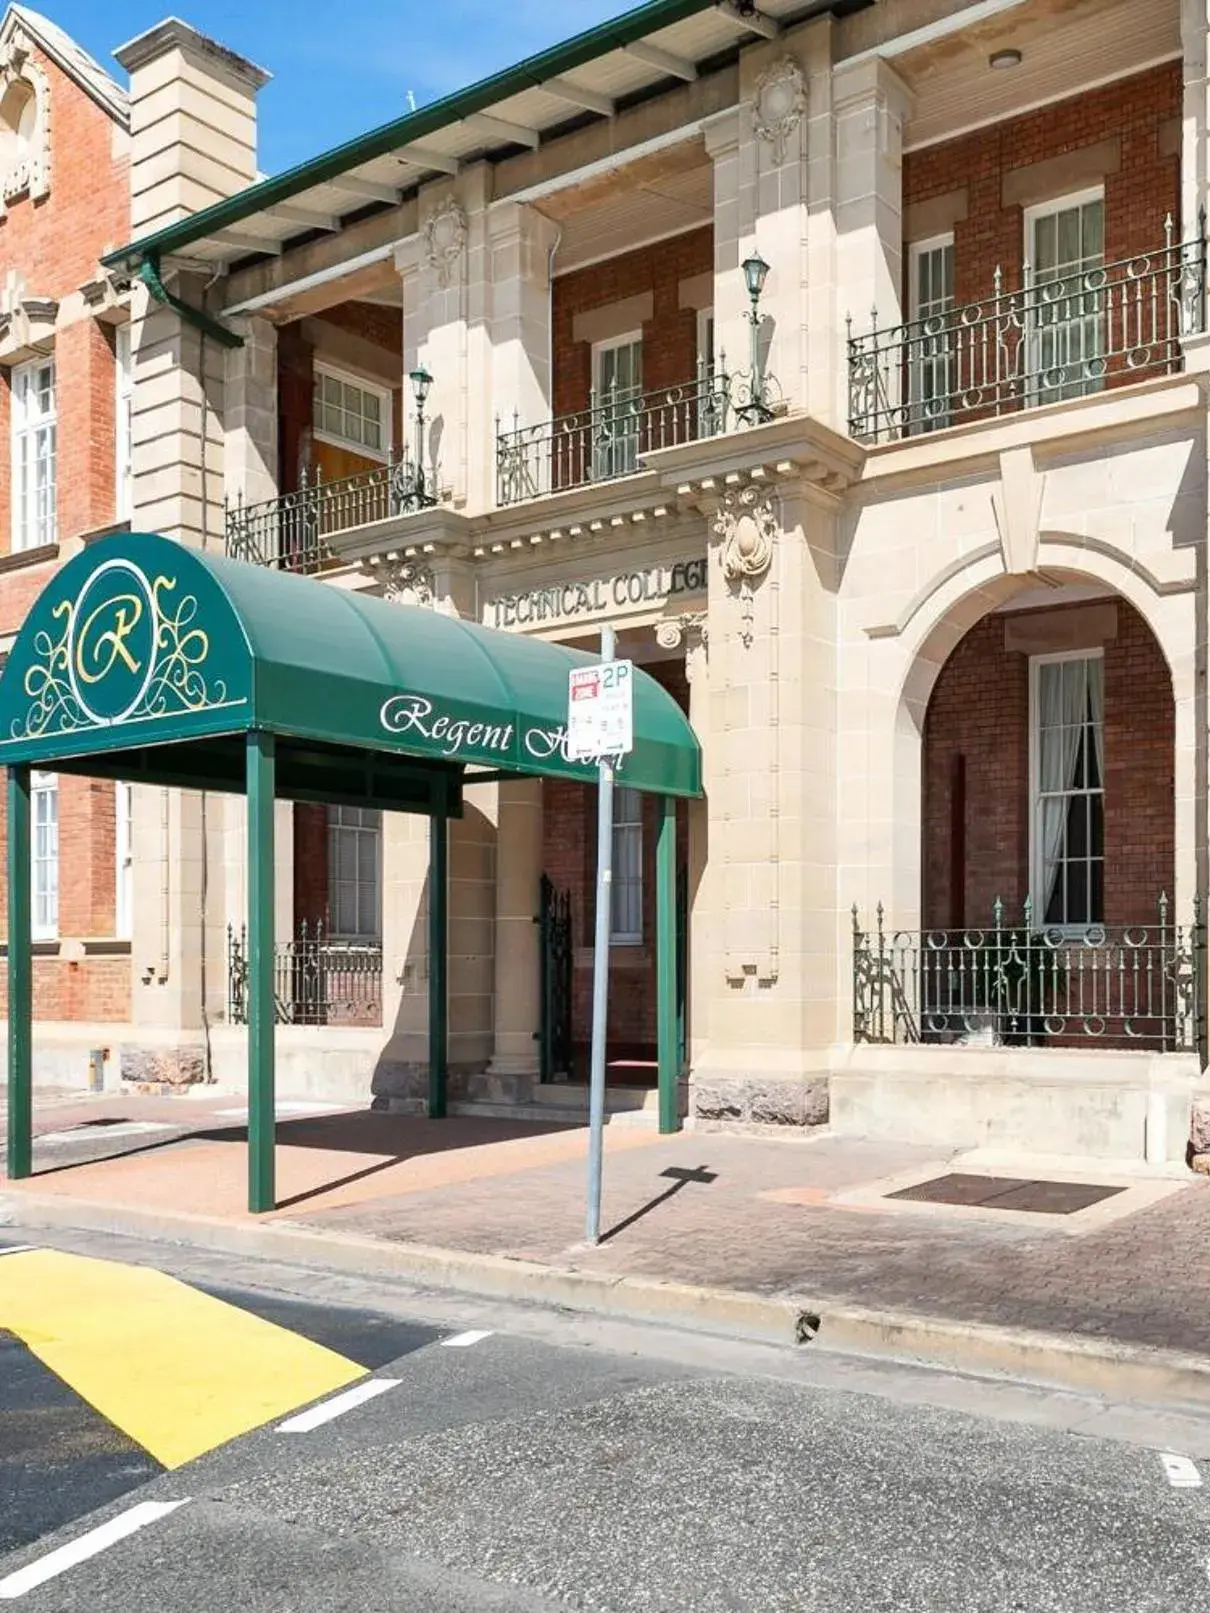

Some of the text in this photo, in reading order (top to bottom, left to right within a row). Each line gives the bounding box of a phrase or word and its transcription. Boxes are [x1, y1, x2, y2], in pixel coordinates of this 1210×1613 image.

[492, 581, 607, 628] TECHNICAL
[602, 665, 628, 690] 2P
[380, 695, 514, 754] Regent
